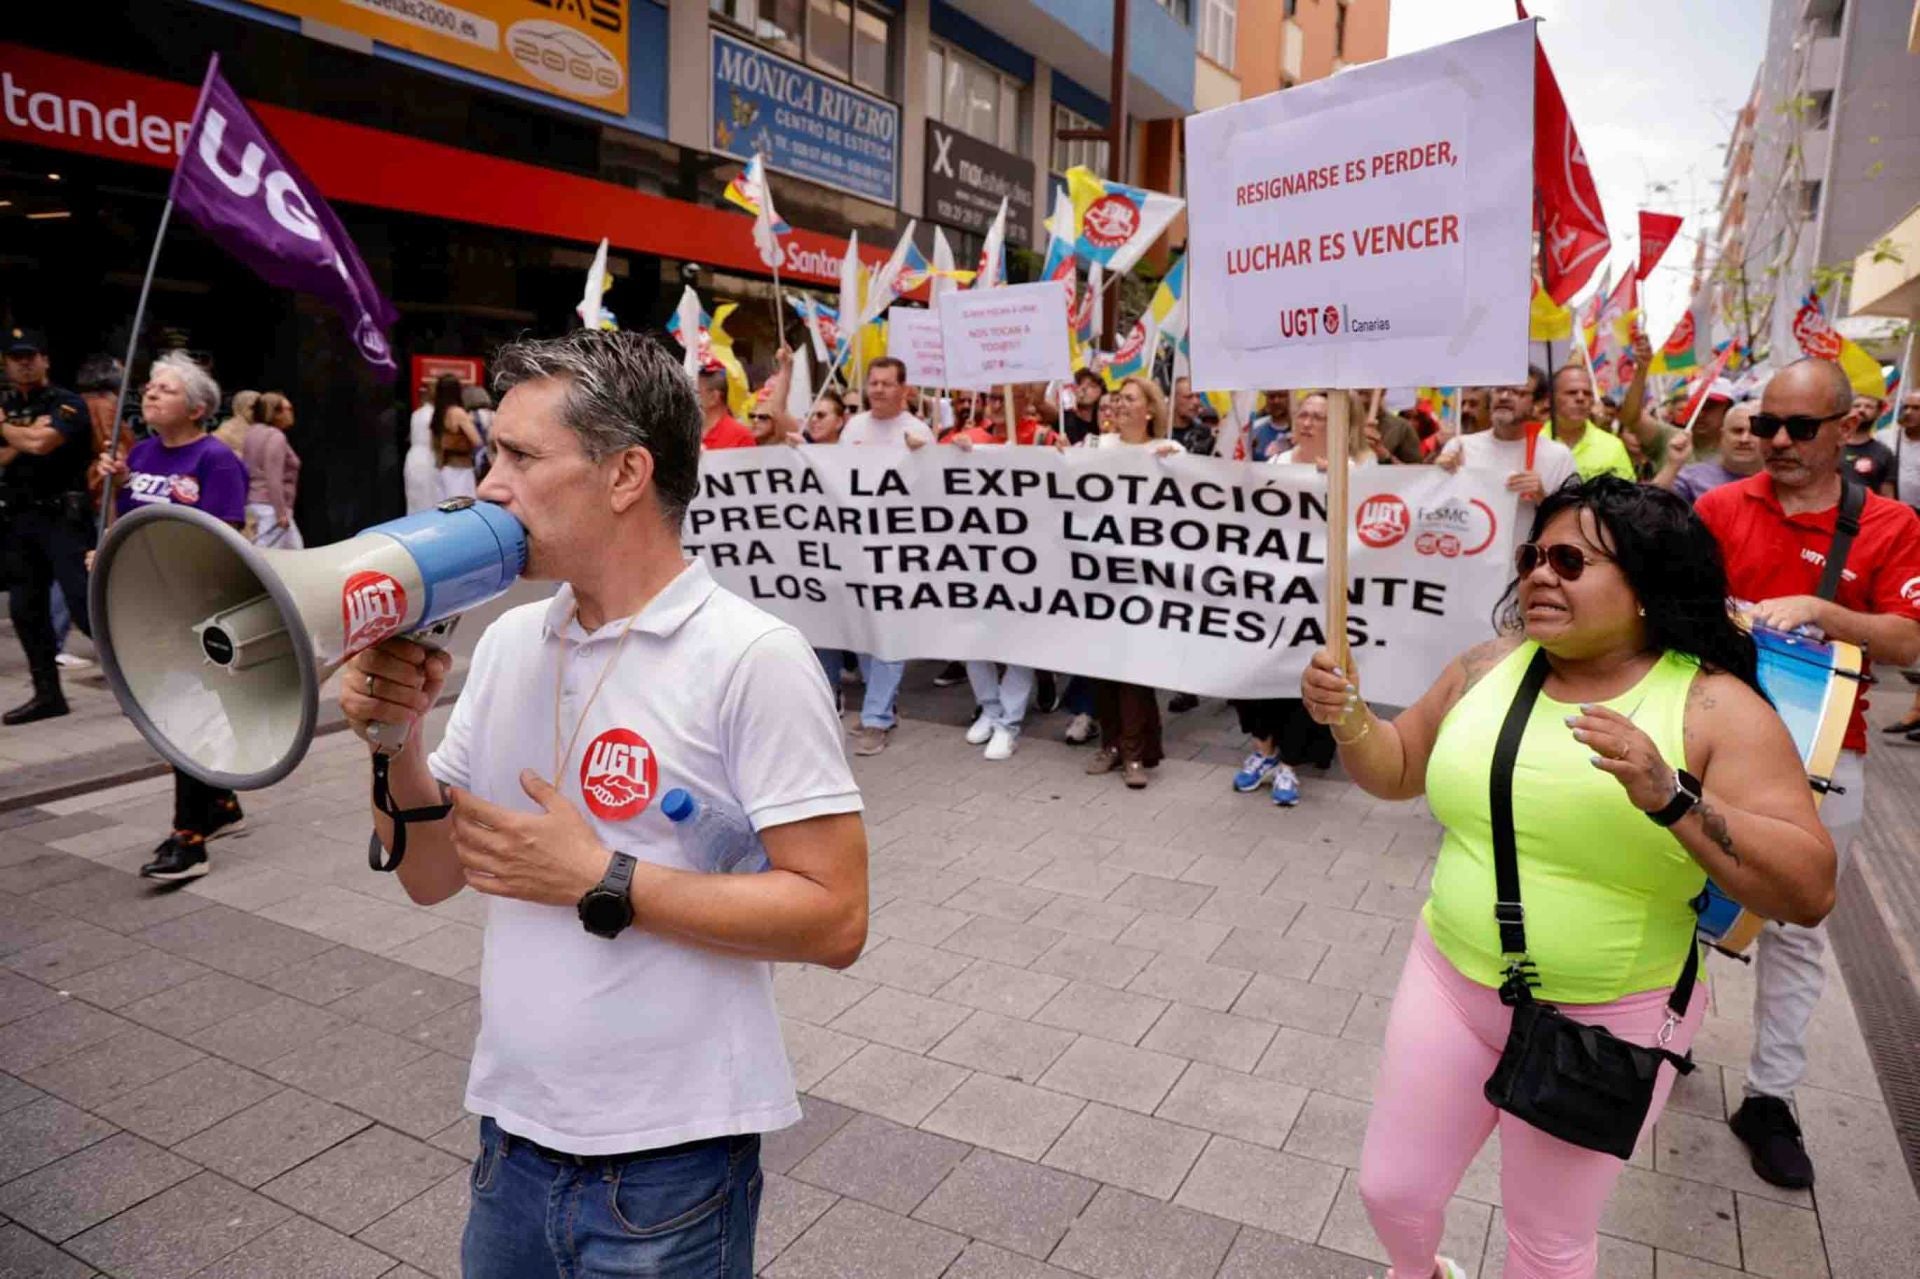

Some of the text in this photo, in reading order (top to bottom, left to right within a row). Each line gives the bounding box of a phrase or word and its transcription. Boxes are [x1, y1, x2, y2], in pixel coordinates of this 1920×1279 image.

[513, 38, 618, 89] 2000
[717, 46, 893, 140] MÓNICA RIVERO
[1236, 141, 1458, 206] RESIGNARSE ES PERDER,
[1227, 214, 1459, 275] LUCHAR ES VENCER
[1280, 307, 1391, 338] UGT Canarias
[693, 467, 1327, 522] NTRA LA EXPLOTACIÓN
[1362, 501, 1405, 525] UGT
[690, 503, 1325, 565] PRECARIEDAD LABORAL
[798, 541, 842, 571] EL
[863, 544, 1038, 575] TRATO
[346, 579, 396, 632] UGT
[749, 574, 1387, 648] LOS TRABAJADORES/AS.
[588, 741, 649, 782] UGT
